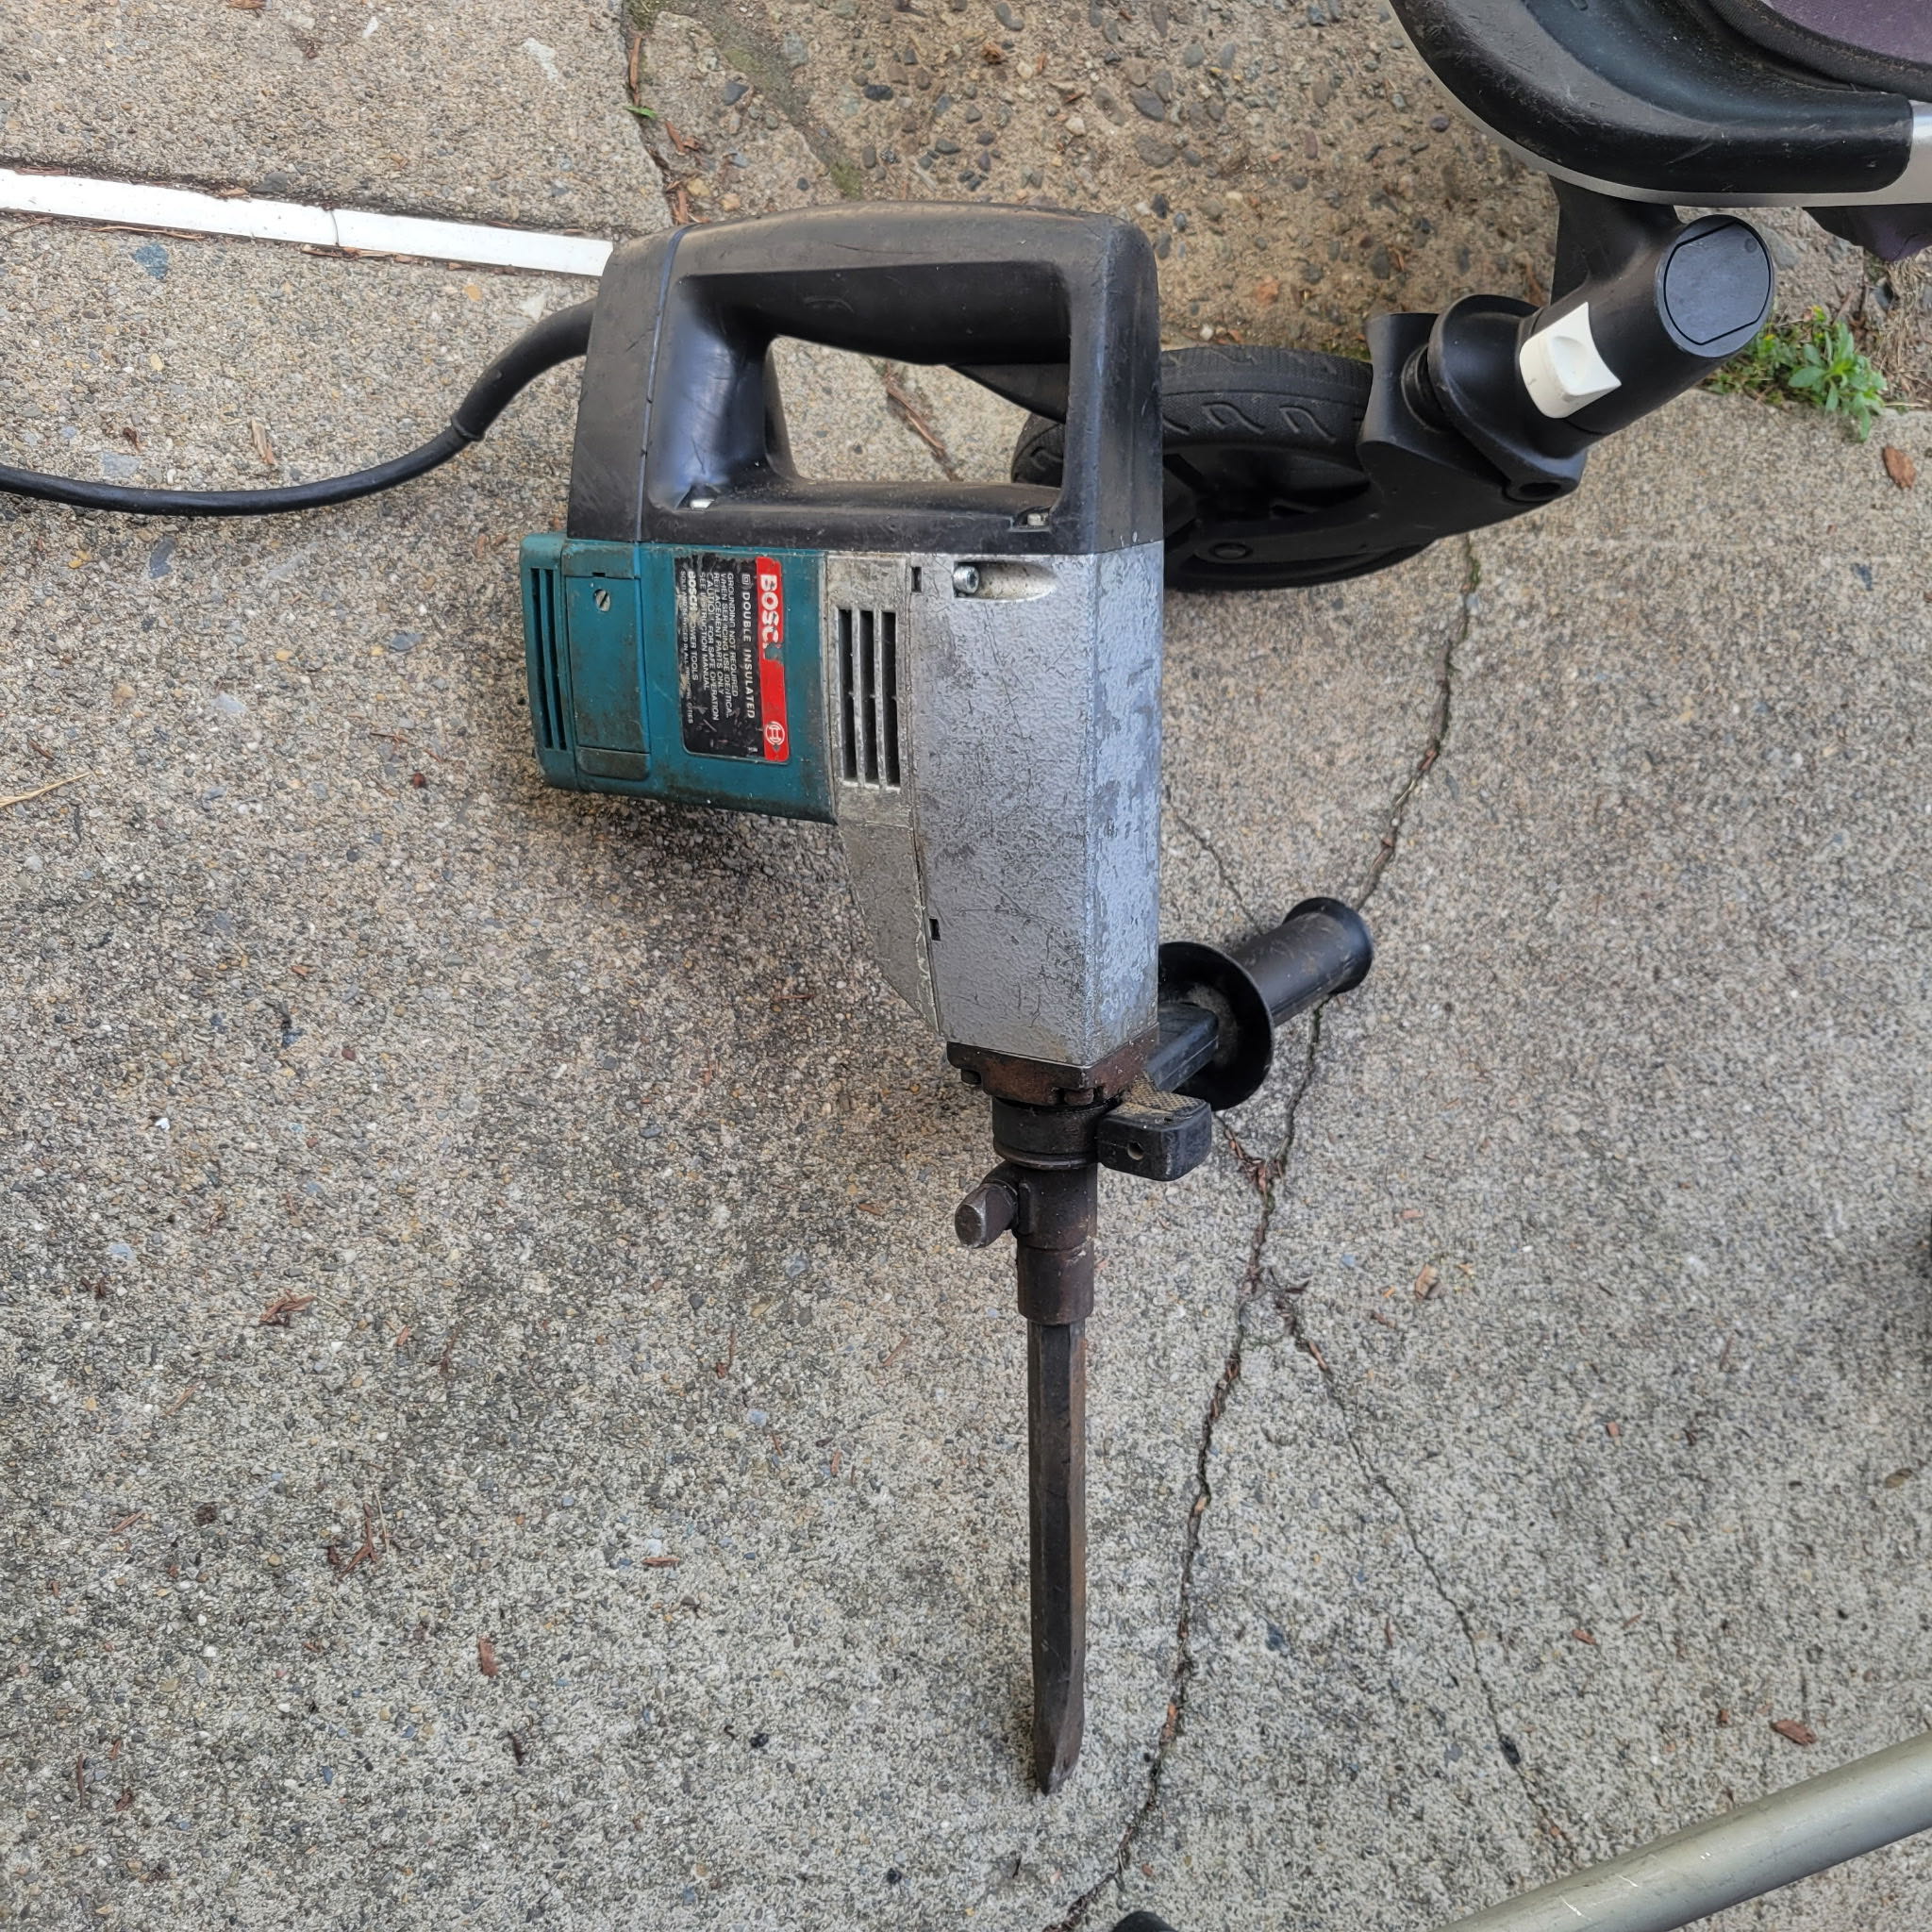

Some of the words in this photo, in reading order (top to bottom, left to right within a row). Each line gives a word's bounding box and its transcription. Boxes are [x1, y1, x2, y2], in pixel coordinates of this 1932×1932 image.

[687, 570, 698, 611] BOSCH
[759, 574, 779, 650] BOSC
[741, 591, 751, 641] DOUBLE
[701, 653, 709, 691] MANUAL
[729, 651, 738, 696] REQUIRED
[742, 648, 755, 719] INSULATED
